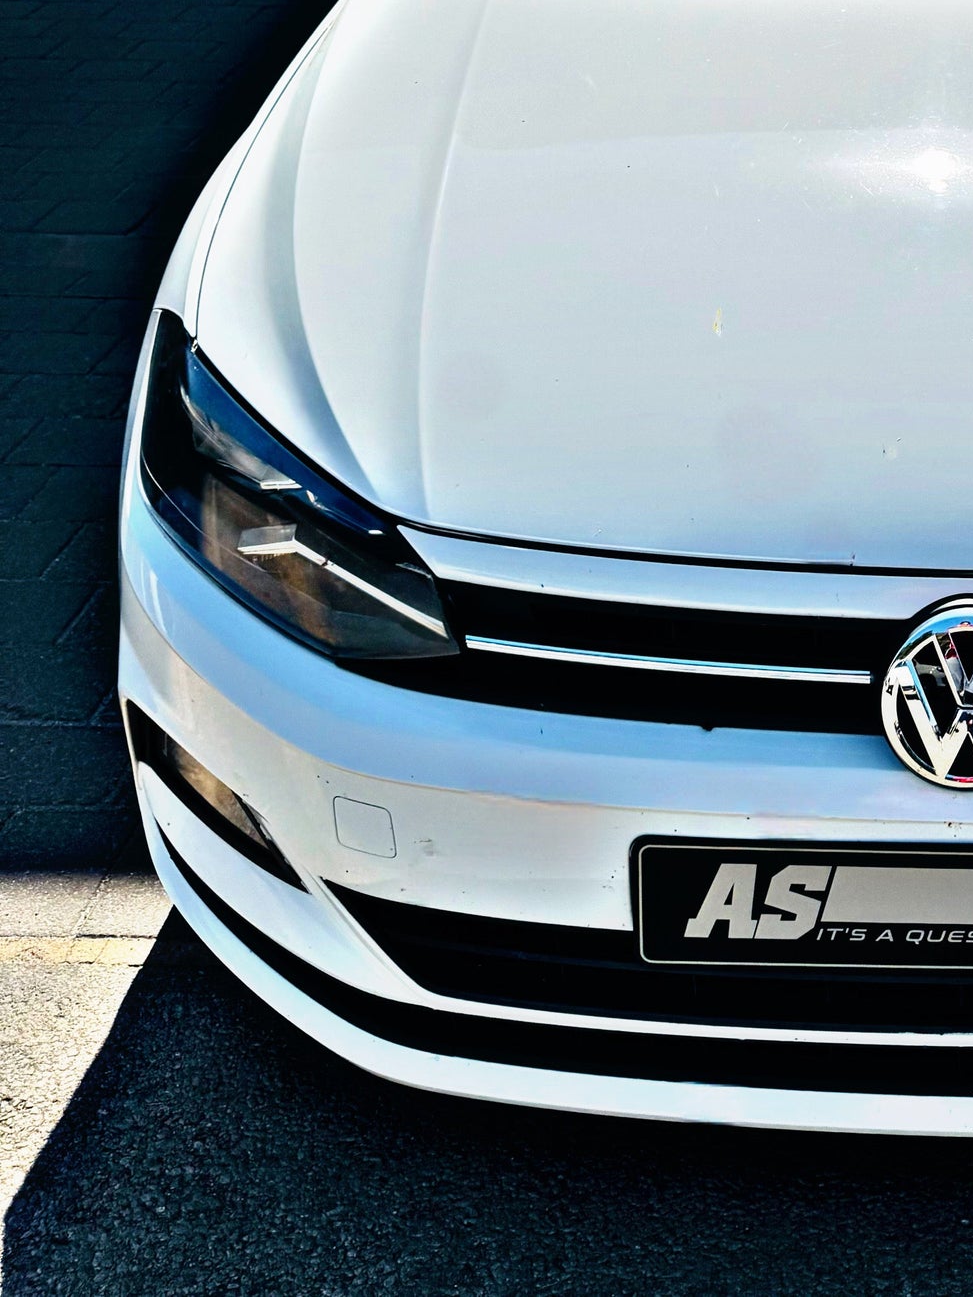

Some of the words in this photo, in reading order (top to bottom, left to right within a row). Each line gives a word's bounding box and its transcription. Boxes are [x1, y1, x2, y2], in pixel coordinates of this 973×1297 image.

[684, 863, 833, 940] AS
[815, 927, 867, 942] IT'S
[874, 929, 896, 943] A
